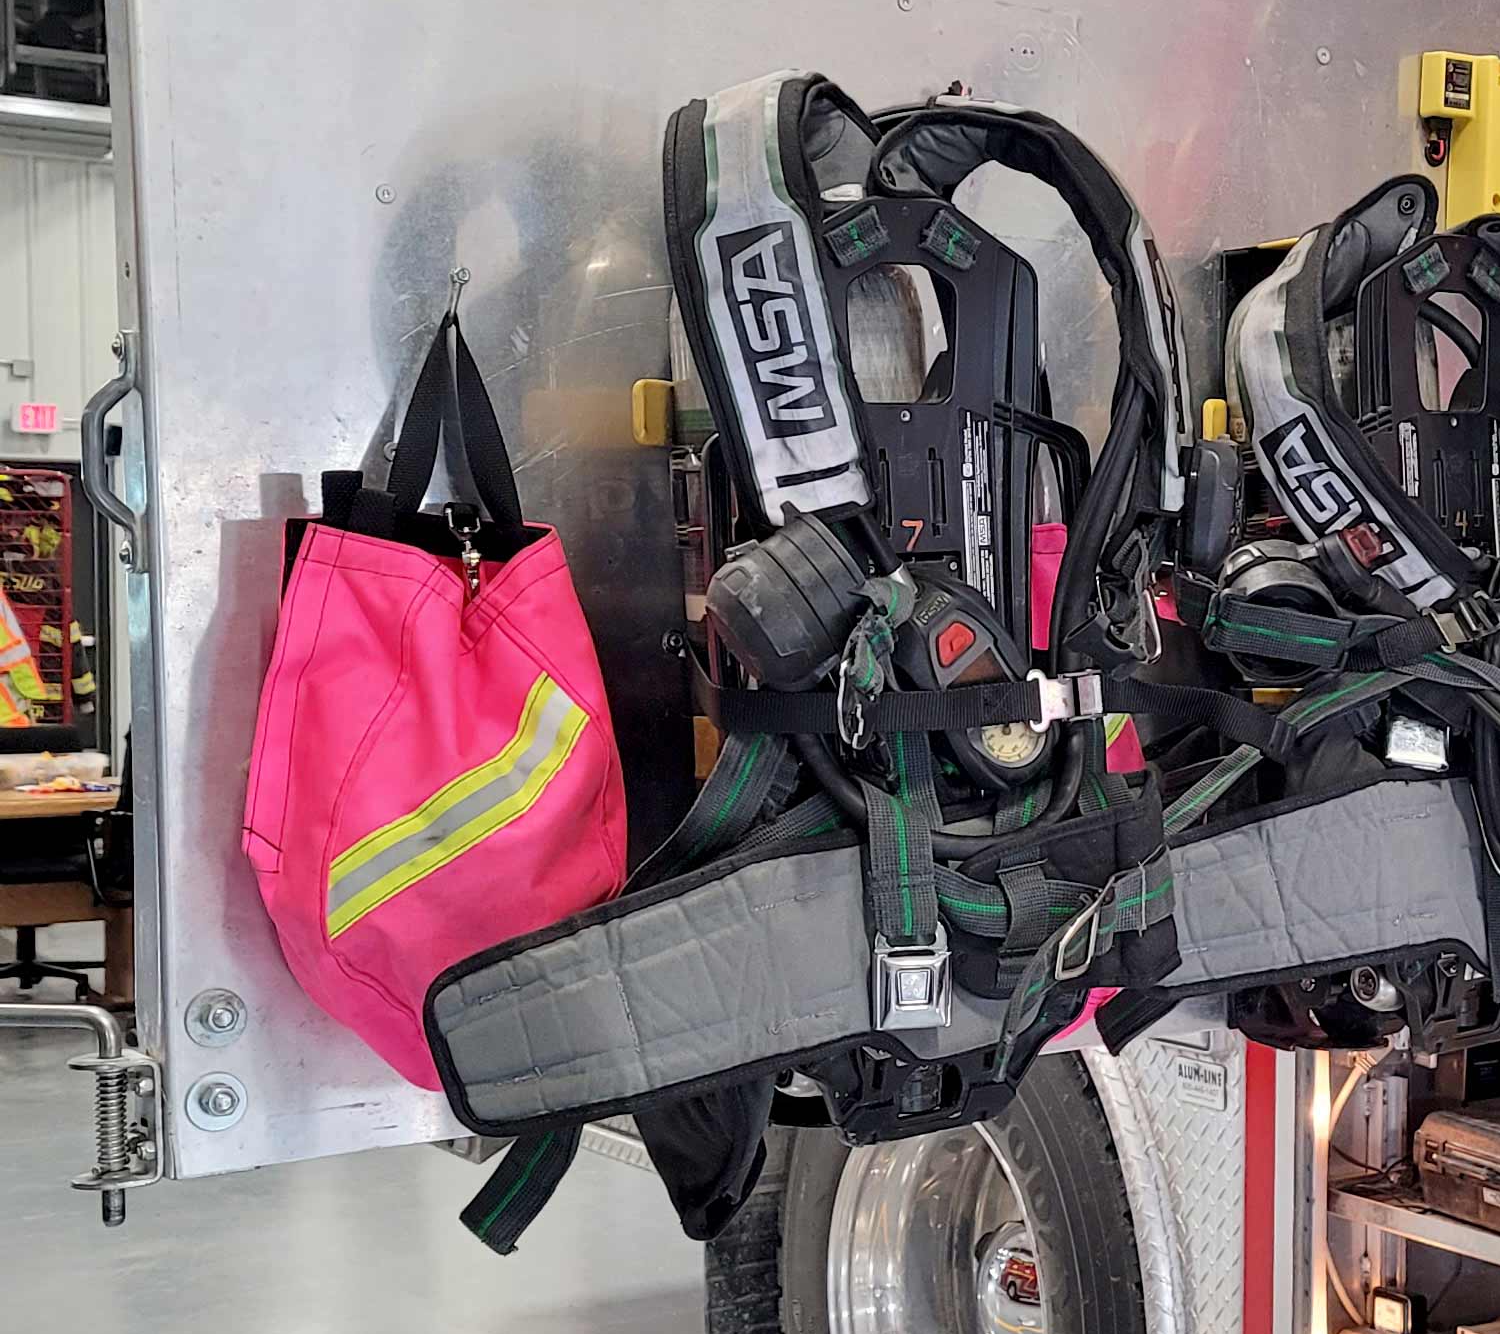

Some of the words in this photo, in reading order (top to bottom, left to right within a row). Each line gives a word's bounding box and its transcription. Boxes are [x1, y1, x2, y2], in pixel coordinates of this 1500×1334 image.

[730, 228, 826, 424] MSA
[21, 405, 57, 429] EXIT
[900, 519, 925, 552] 7
[1454, 509, 1469, 538] 4
[1177, 1063, 1222, 1087] ALUM-LINE
